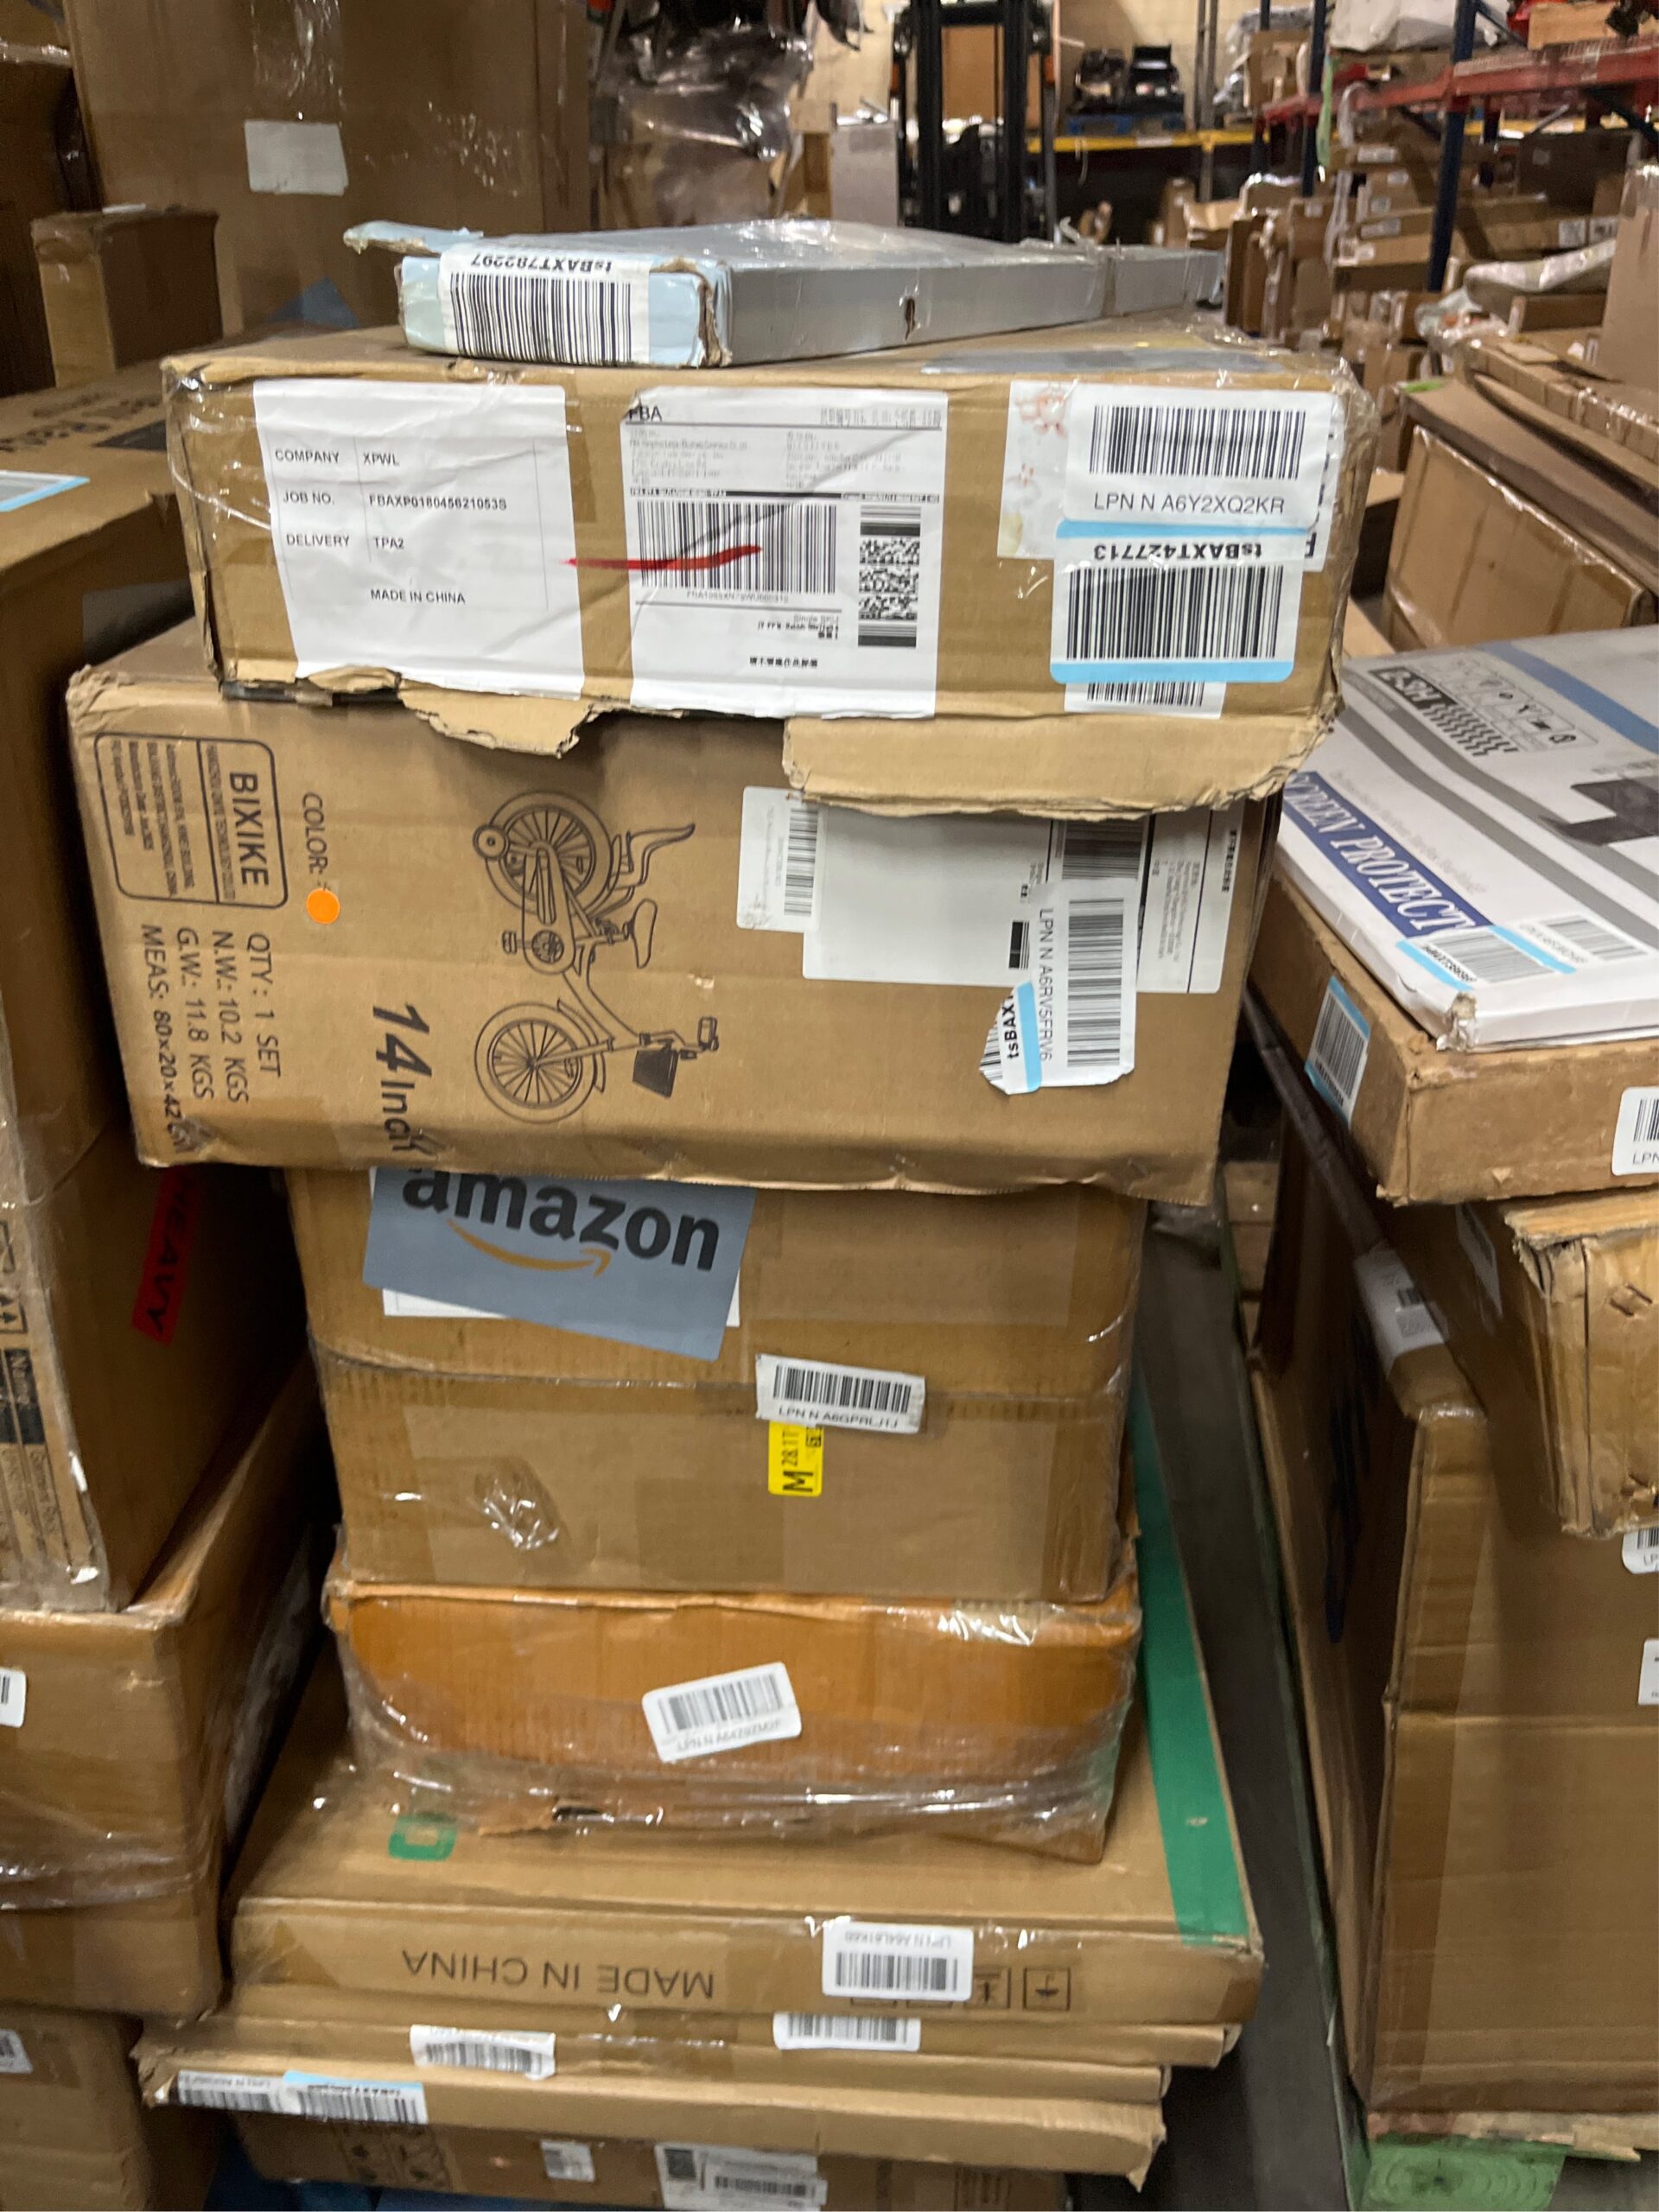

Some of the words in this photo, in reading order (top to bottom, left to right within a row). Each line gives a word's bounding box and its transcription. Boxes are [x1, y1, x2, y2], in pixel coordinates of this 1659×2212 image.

[275, 448, 340, 465] COMPANY
[363, 452, 400, 467] XPWL
[283, 491, 309, 505] JOB
[312, 492, 335, 505] NO.
[1094, 491, 1135, 512] LPN
[1141, 493, 1156, 511] N
[1160, 493, 1286, 515] A6Y2XQ2KR
[286, 533, 351, 549] DELIVERY
[374, 537, 405, 550] TPA2
[1093, 542, 1262, 561] tsBAXT427713
[371, 588, 407, 603] MADE
[410, 590, 423, 603] IN
[425, 590, 467, 605] CHINA
[228, 772, 270, 887] BIXIKE
[1039, 907, 1054, 943] LPN
[141, 924, 170, 1000] MEAS:
[1039, 947, 1053, 961] N
[184, 998, 209, 1042] 11.8
[219, 997, 243, 1045] 10.2
[257, 1033, 282, 1078] SET
[188, 1053, 214, 1101] KGS
[223, 1057, 249, 1103] KGS
[402, 1168, 720, 1272] amazon
[778, 1406, 805, 1419] LPN
[782, 1470, 814, 1493] M
[401, 1948, 529, 1986] CHINA
[543, 1961, 581, 1992] IN
[596, 1963, 715, 1999] MADE
